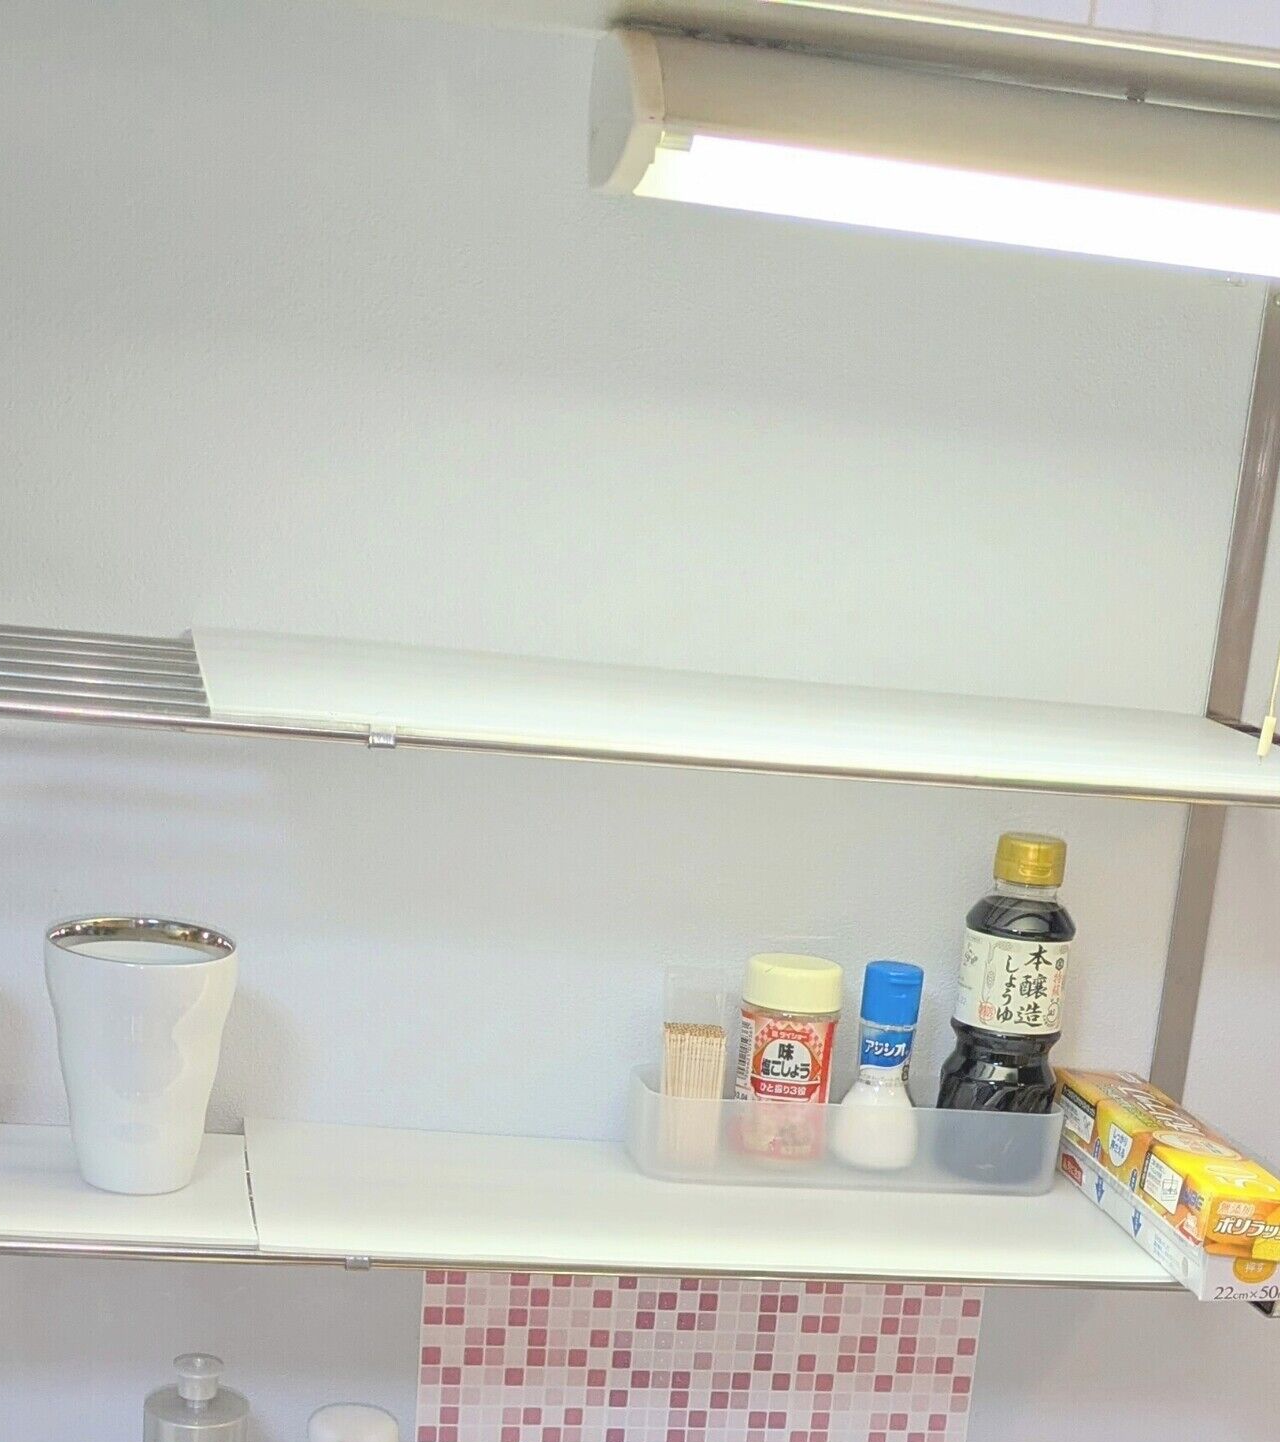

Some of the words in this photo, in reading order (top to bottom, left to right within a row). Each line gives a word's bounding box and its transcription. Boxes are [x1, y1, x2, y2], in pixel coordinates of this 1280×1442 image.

[996, 954, 1019, 1024] しょうゆ
[777, 1043, 795, 1061] 味
[865, 1040, 908, 1058] アジシオ
[761, 1058, 811, 1080] 塩こしょう
